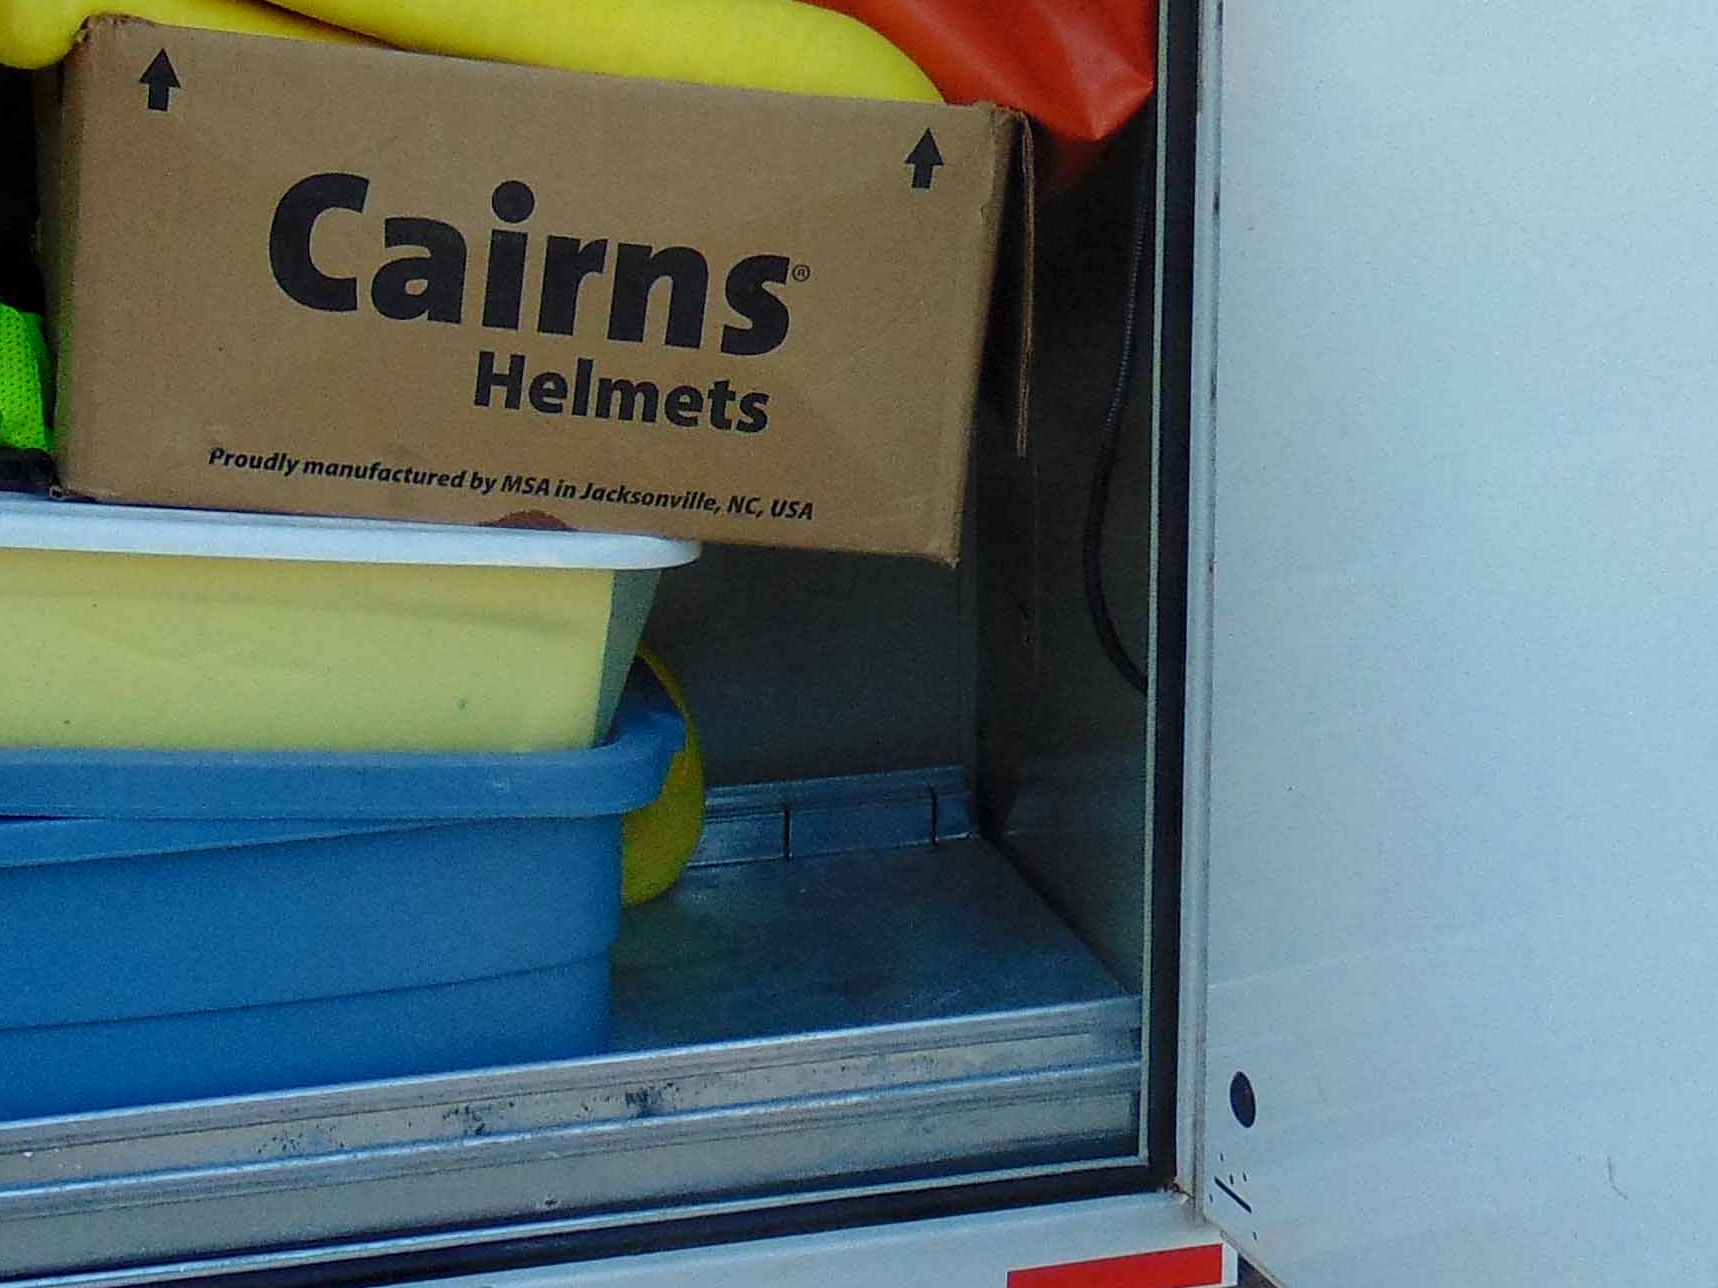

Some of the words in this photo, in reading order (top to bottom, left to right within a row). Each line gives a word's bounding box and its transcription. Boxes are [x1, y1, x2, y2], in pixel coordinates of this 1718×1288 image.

[472, 350, 770, 434] Helmets
[208, 447, 300, 477] Proudly
[302, 458, 467, 489] manufactured
[469, 470, 498, 495] by
[501, 474, 550, 497] MSA
[553, 478, 576, 499] in
[579, 482, 721, 513] Jacksonville,
[726, 496, 765, 519] NC,
[770, 498, 814, 521] USA
